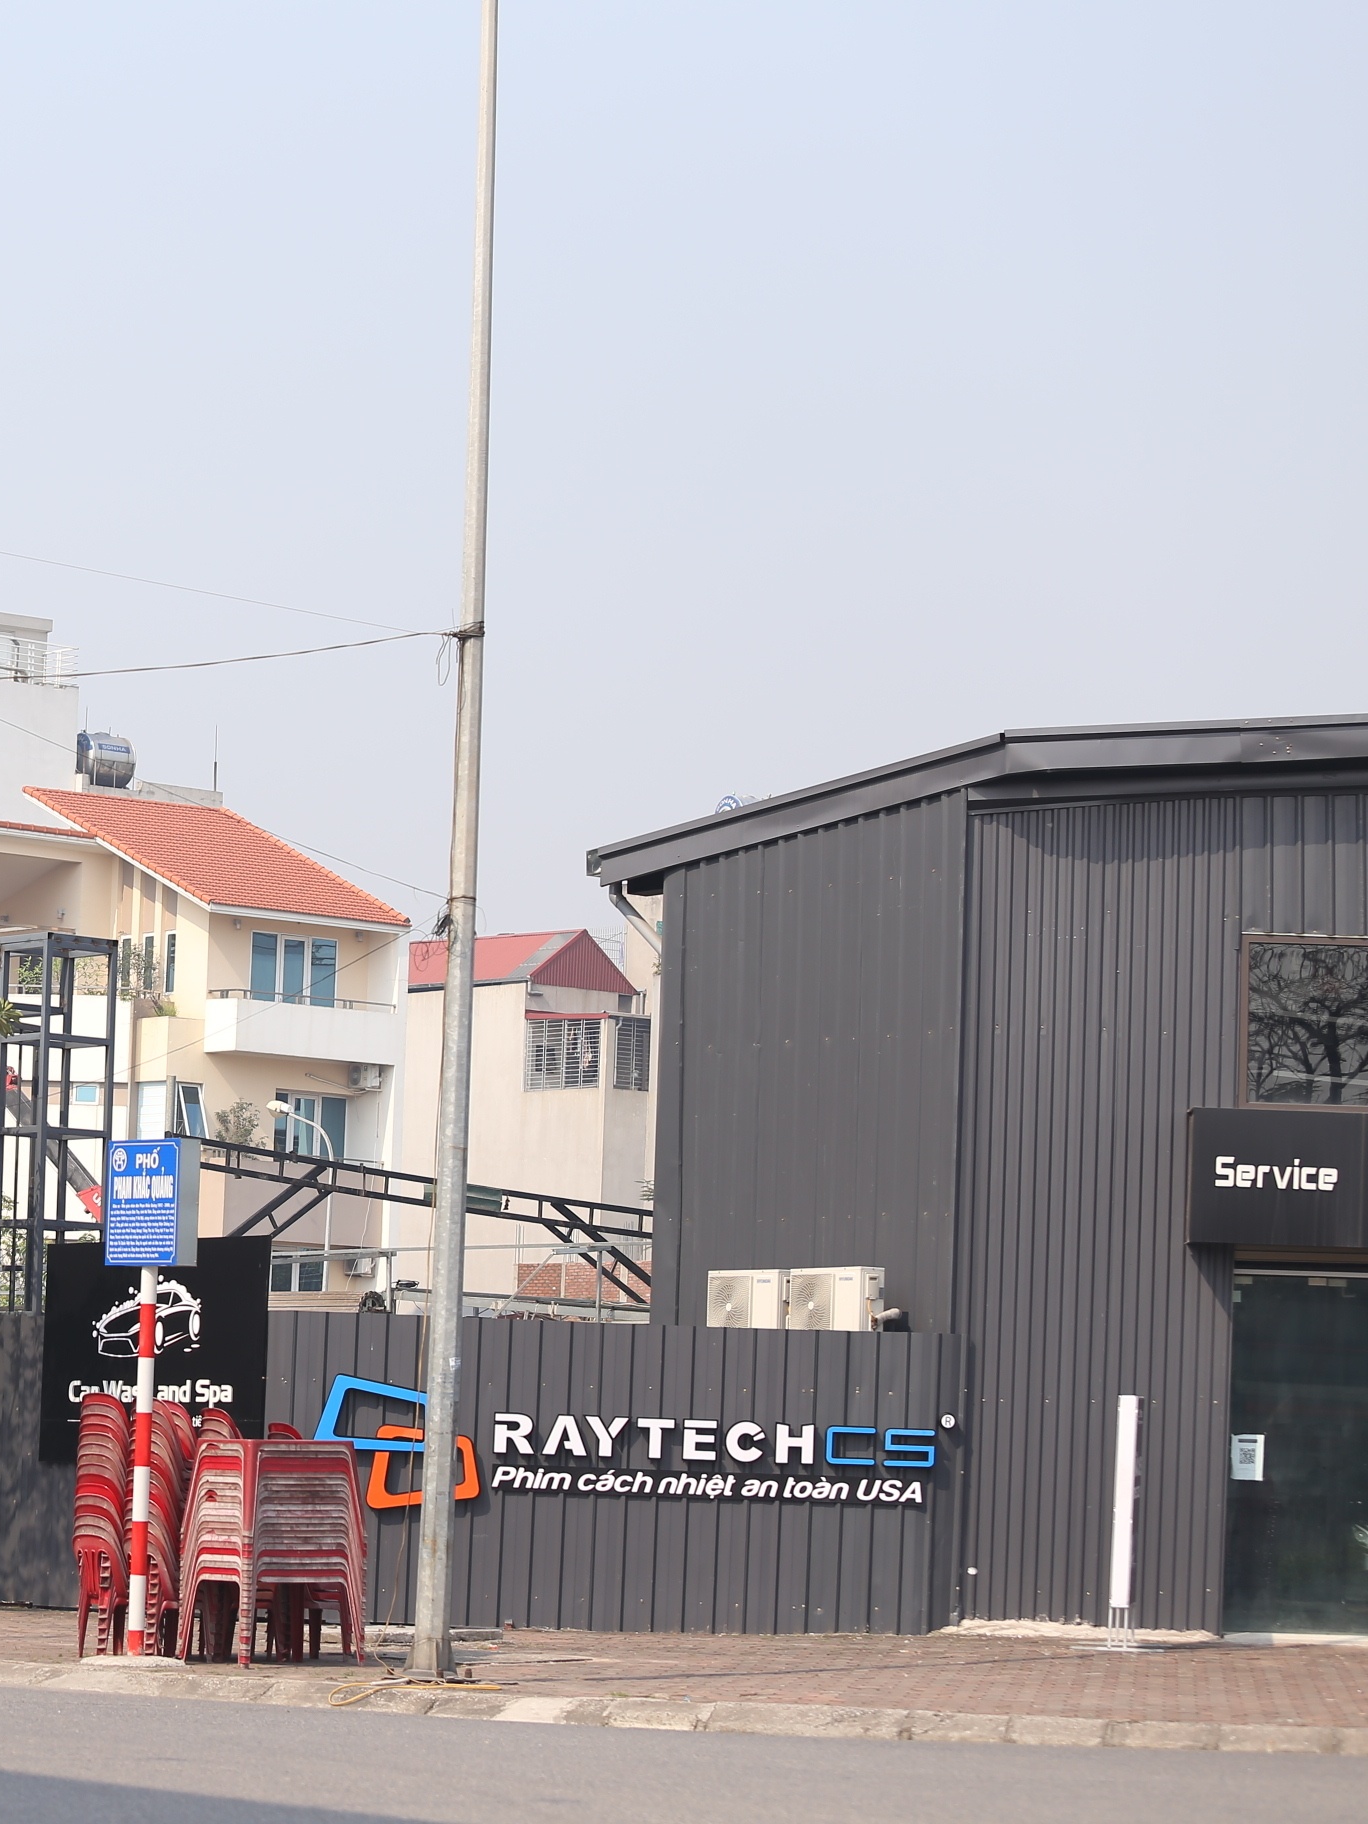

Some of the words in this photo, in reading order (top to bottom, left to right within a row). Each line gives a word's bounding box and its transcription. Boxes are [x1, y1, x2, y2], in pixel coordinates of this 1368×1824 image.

[135, 1146, 161, 1169] PHỐ
[1214, 1155, 1339, 1191] Service
[113, 1175, 132, 1204] PHẠM
[68, 1380, 100, 1402] Car
[157, 1379, 191, 1403] and
[195, 1379, 233, 1409] Spa
[493, 1412, 936, 1468] RAYTECHCS
[491, 1465, 572, 1490] Phim
[577, 1469, 654, 1494] cách
[657, 1473, 736, 1499] nhiệt
[740, 1478, 779, 1498] an
[782, 1476, 850, 1500] toàn
[856, 1479, 923, 1503] USA
